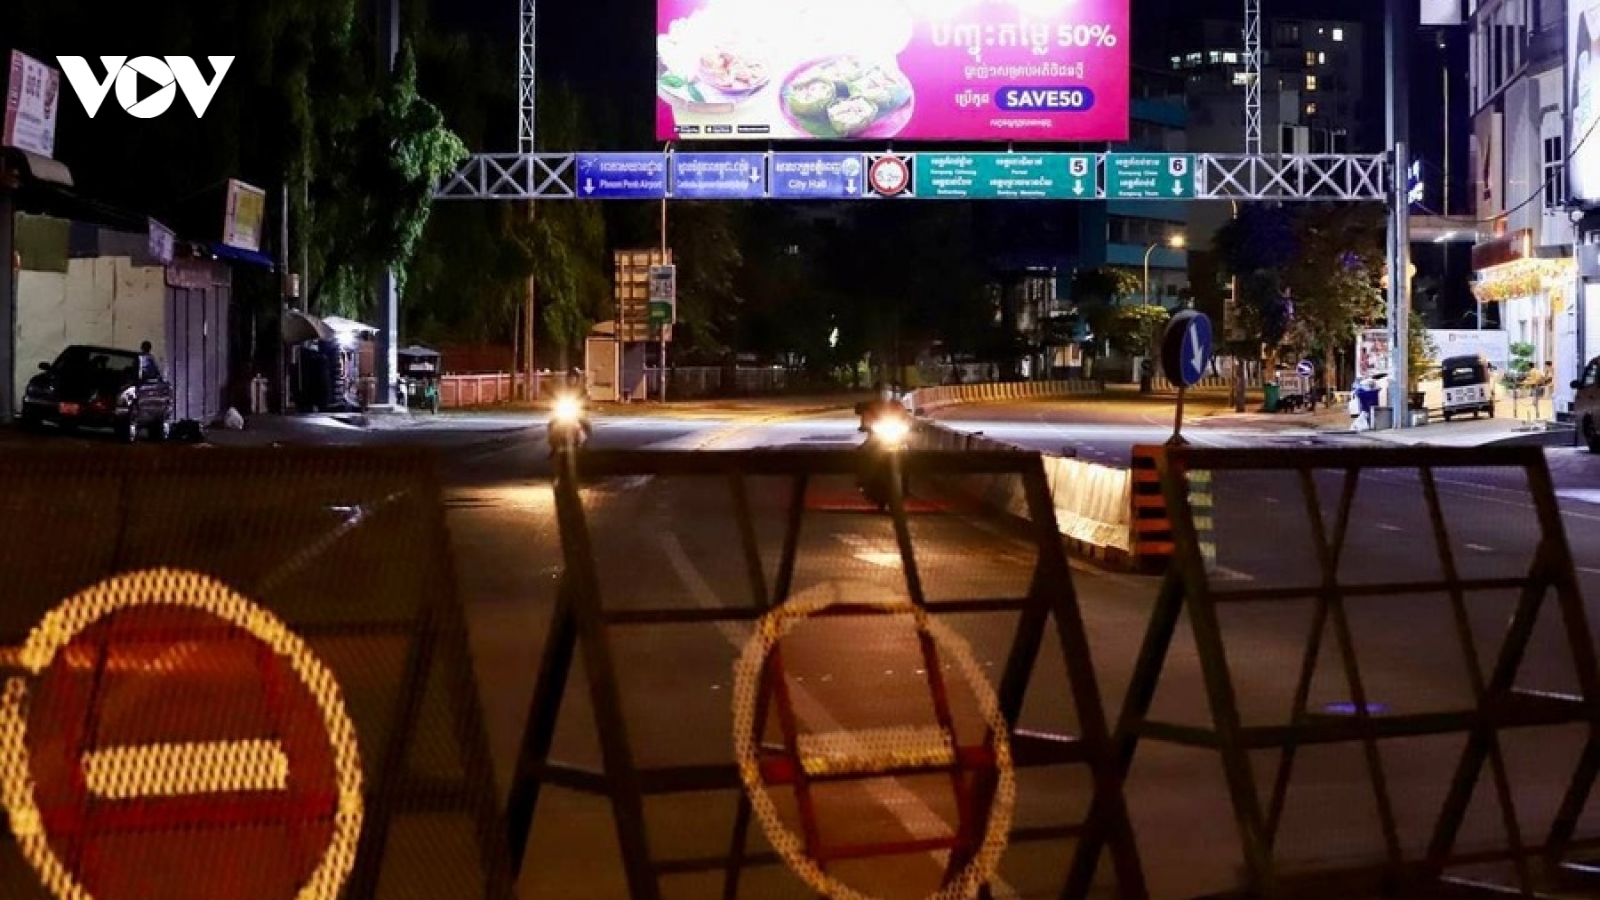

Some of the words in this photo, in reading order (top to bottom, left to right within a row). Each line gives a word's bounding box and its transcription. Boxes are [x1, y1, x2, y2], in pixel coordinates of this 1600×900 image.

[1058, 24, 1117, 47] 50%
[1006, 90, 1084, 107] SAVE50
[1073, 159, 1084, 173] 5
[1172, 159, 1183, 172] 6
[788, 179, 807, 191] City
[809, 179, 828, 189] Hall
